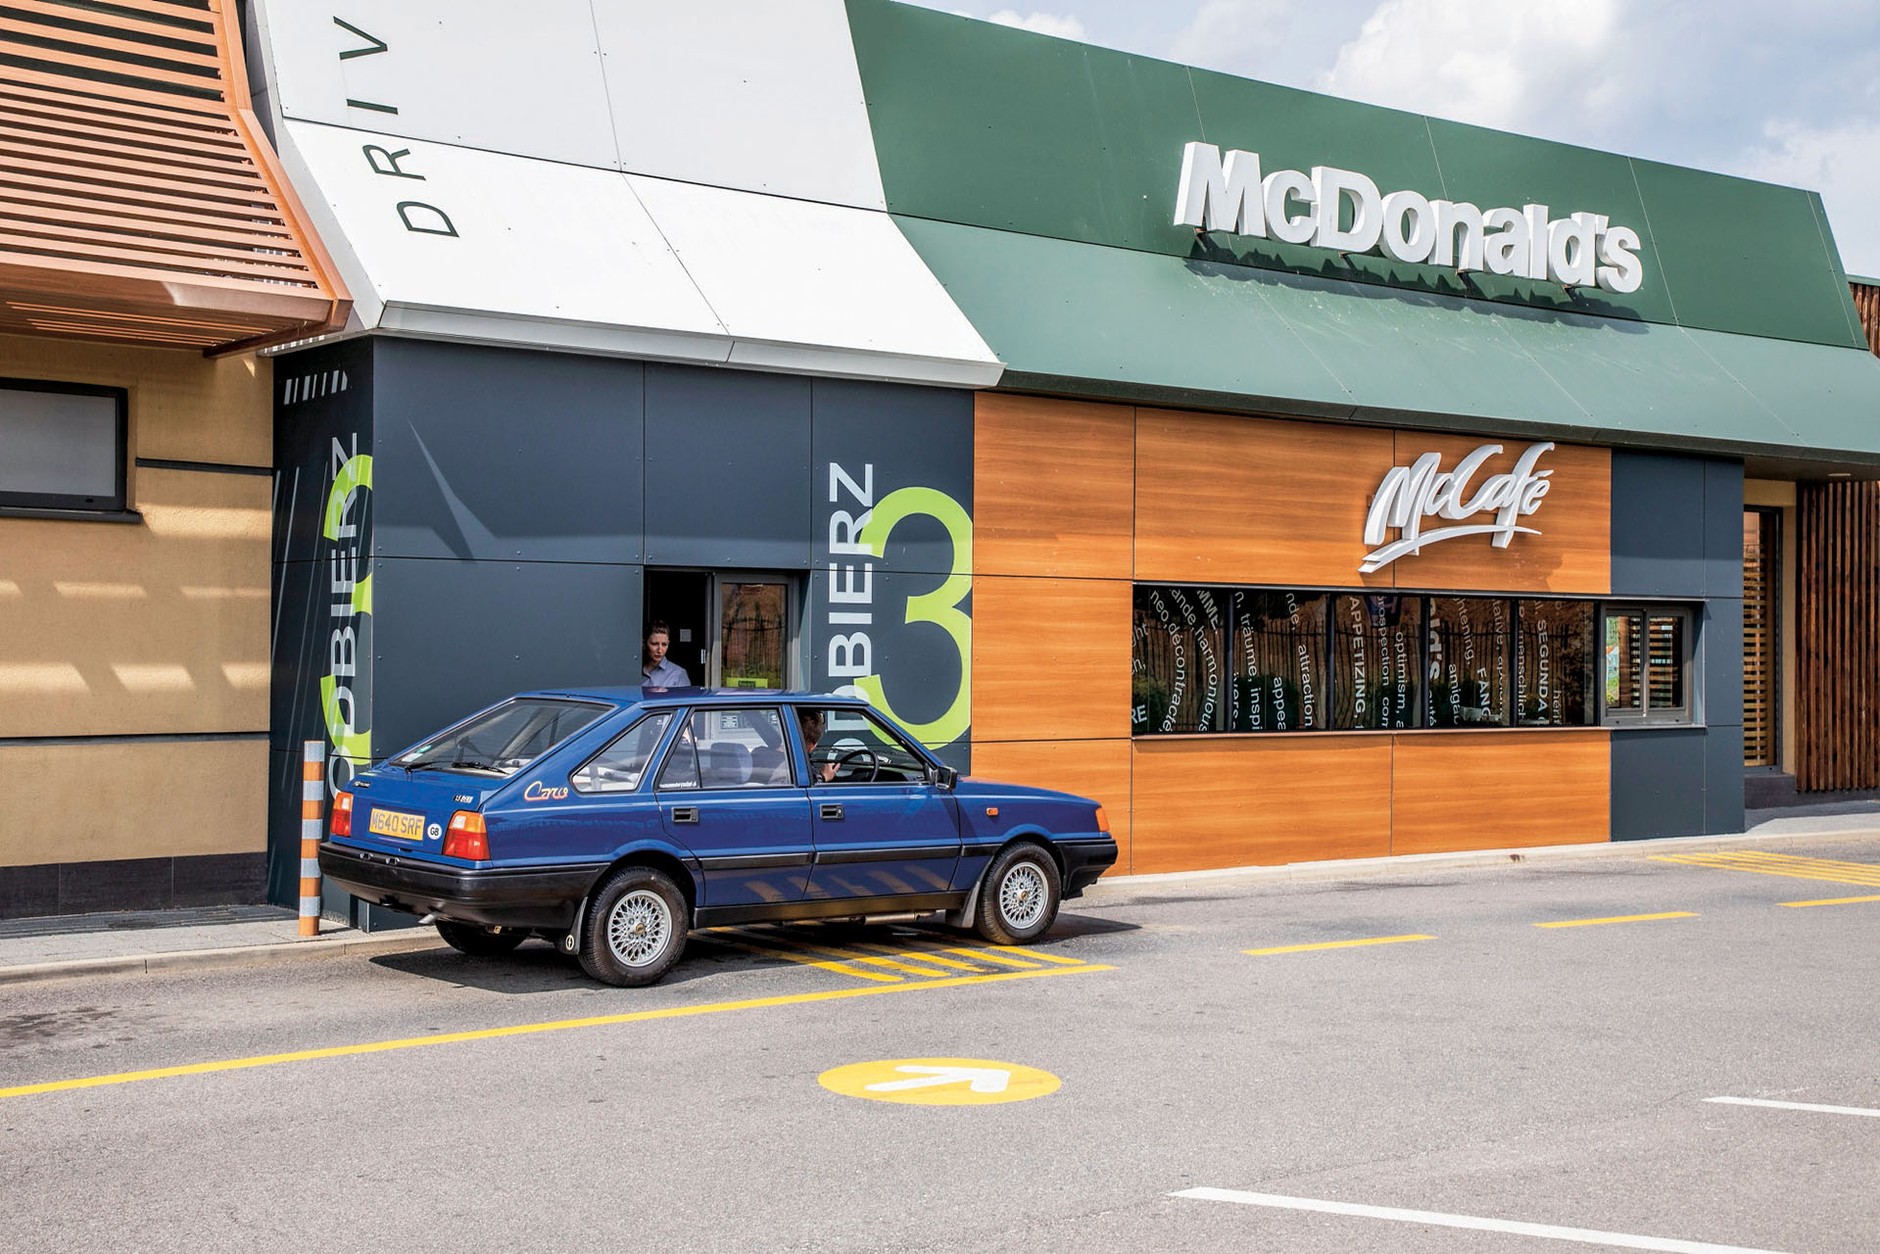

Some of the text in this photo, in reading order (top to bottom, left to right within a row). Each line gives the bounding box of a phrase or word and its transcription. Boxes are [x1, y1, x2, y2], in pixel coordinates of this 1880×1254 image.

[1173, 141, 1643, 293] McDonald's
[1362, 442, 1555, 557] McCafé
[854, 487, 973, 751] 3
[1241, 613, 1257, 683] träume,
[1195, 626, 1218, 732] harmonious
[1298, 644, 1315, 727] attraction
[1395, 631, 1408, 714] optimism,
[1537, 619, 1549, 712] SEGUNDA
[400, 815, 423, 836] SRF
[430, 827, 440, 837] GB
